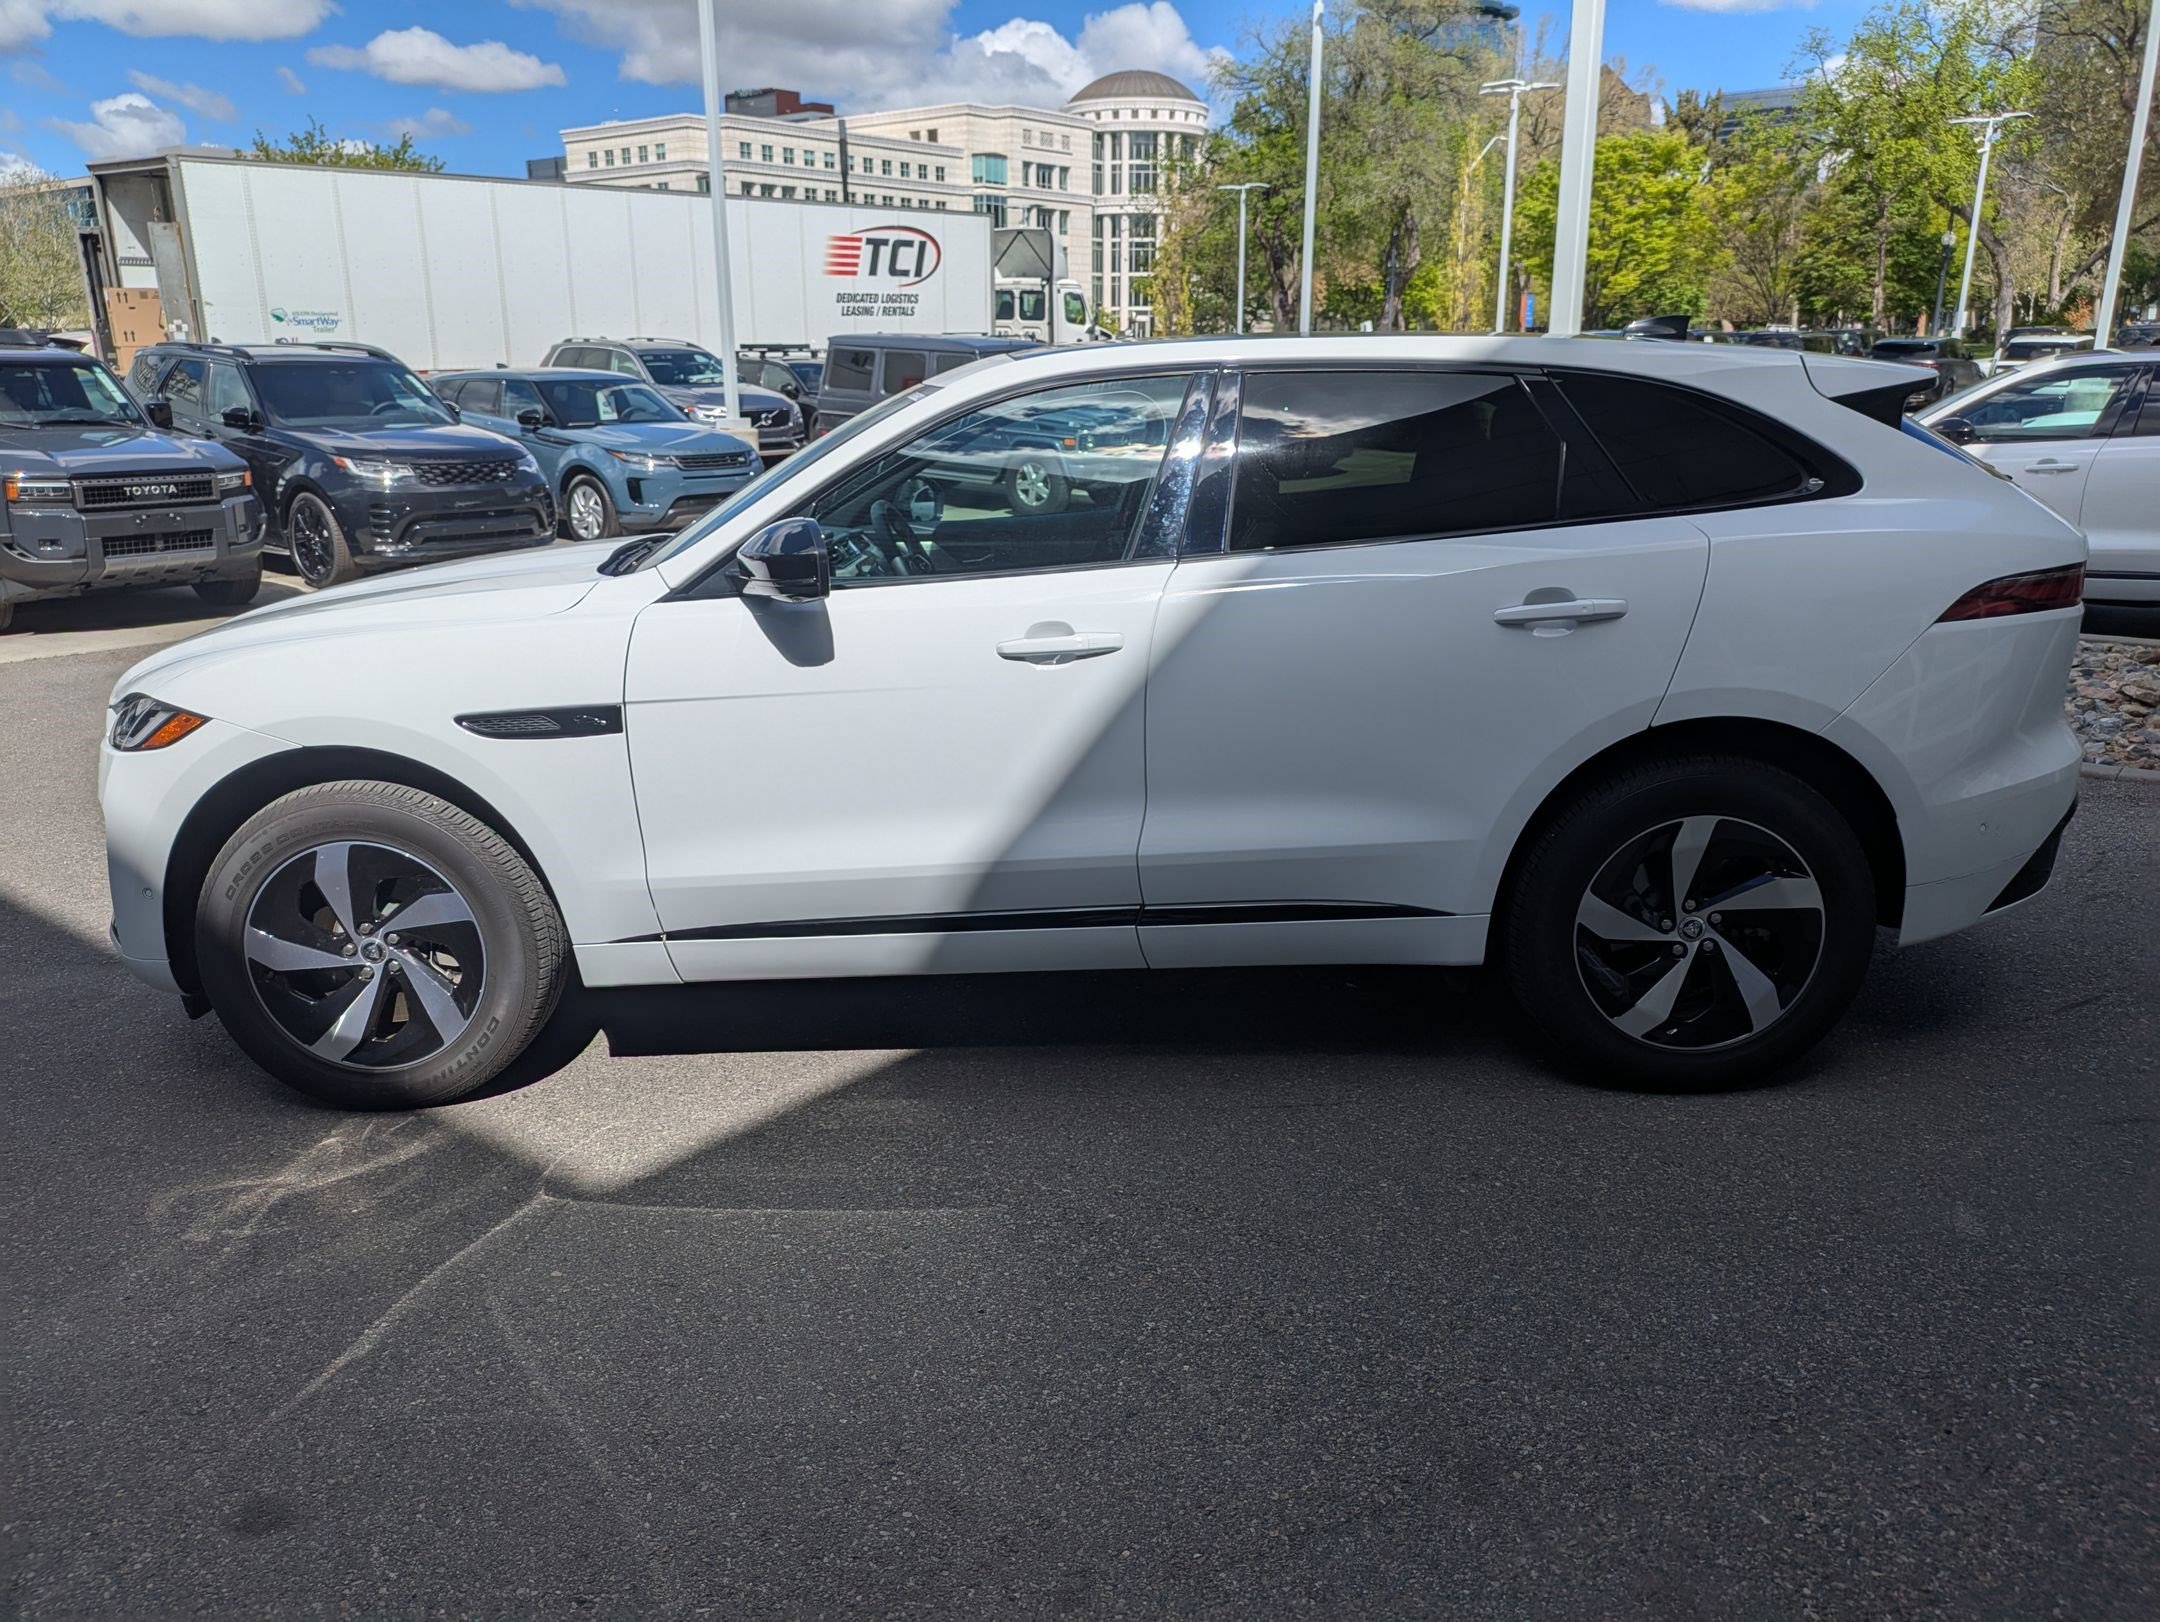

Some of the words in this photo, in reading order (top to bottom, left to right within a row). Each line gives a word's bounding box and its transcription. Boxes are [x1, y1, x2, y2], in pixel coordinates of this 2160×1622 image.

[865, 237, 928, 278] TCI
[836, 292, 879, 304] DEDICATED
[881, 293, 919, 304] LOGISTICS
[841, 305, 875, 317] LEASING
[881, 306, 915, 317] RENTALS
[292, 315, 338, 329] SmartWay
[123, 484, 178, 496] TOYOTA
